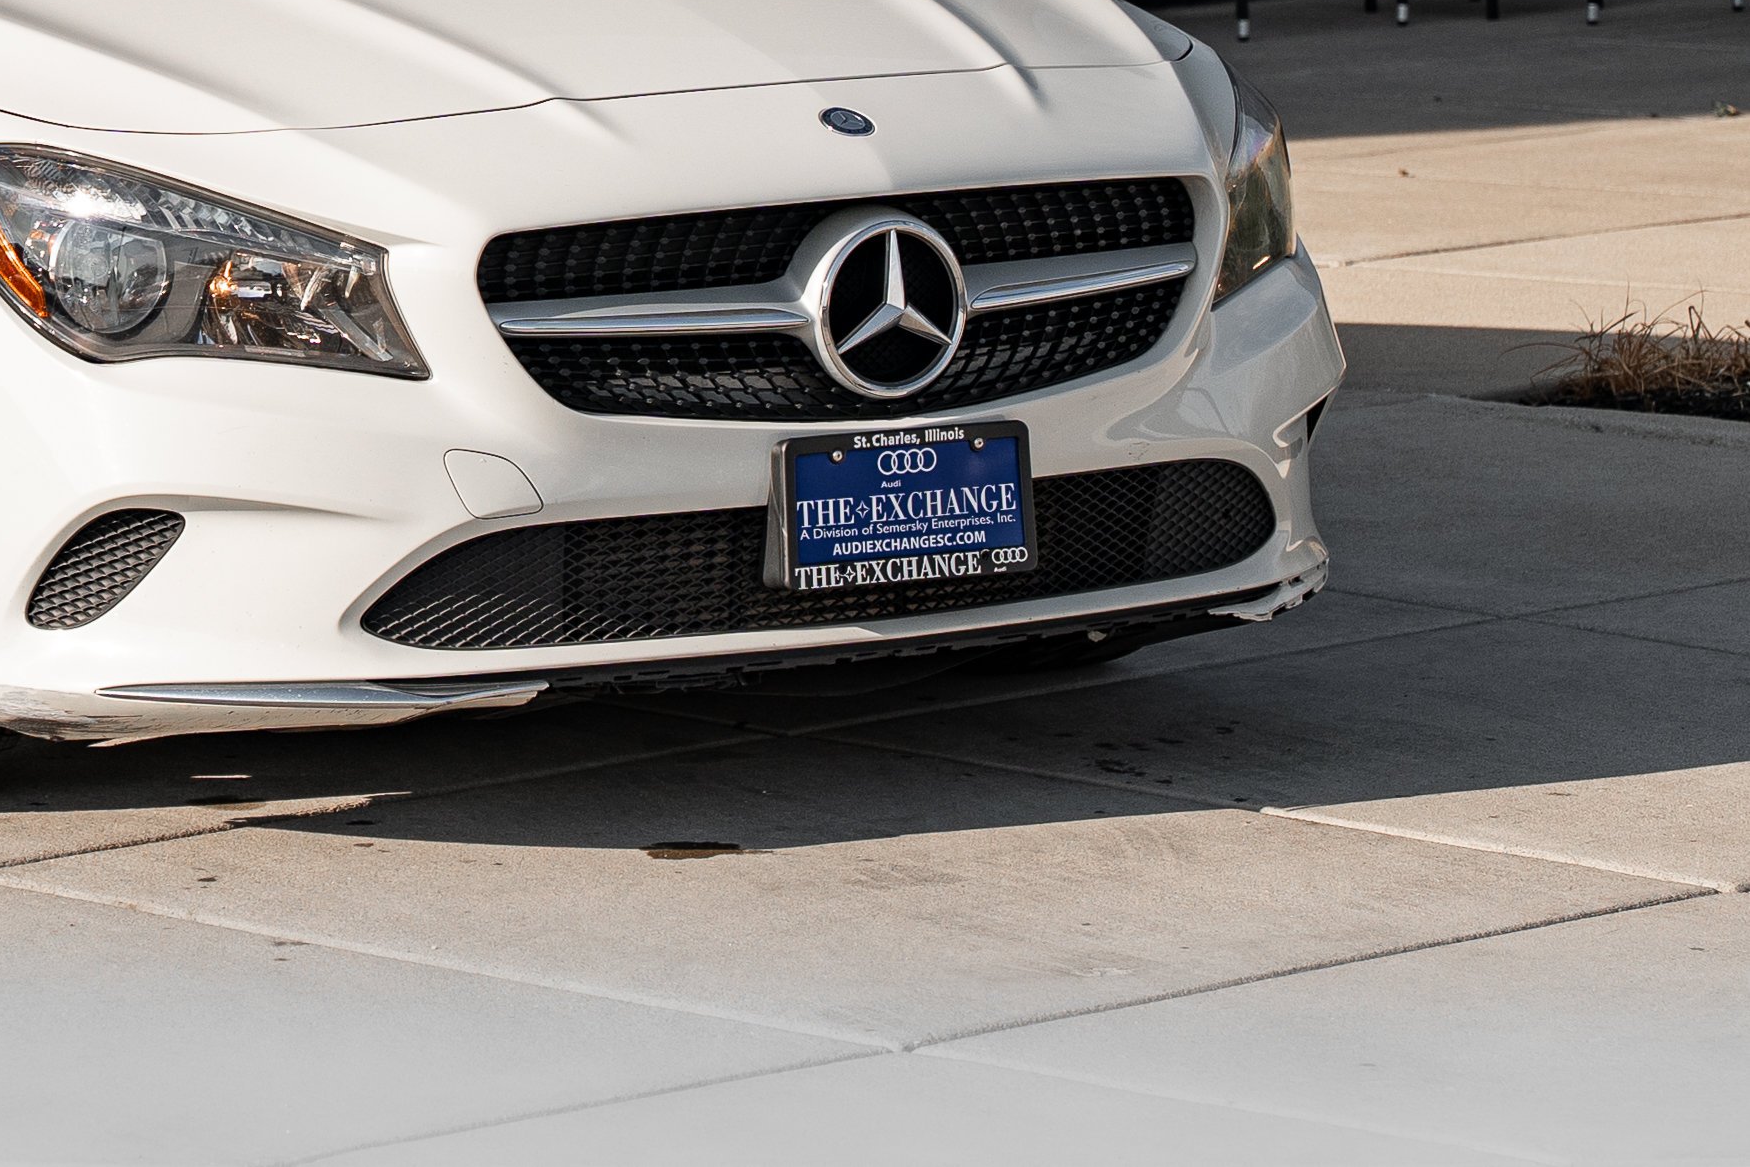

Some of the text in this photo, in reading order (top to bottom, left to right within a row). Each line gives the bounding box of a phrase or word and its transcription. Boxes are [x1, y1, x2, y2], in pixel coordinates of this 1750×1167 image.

[853, 426, 965, 448] St. Charles, Illinois
[880, 479, 902, 489] Audi
[796, 482, 1017, 528] THE EXCHANGE
[799, 512, 1016, 541] A Division of Semersky Enterprises, Inc.
[832, 530, 986, 556] AUDIEXCHANGESC.COM
[794, 550, 982, 590] THE EXCHANGE
